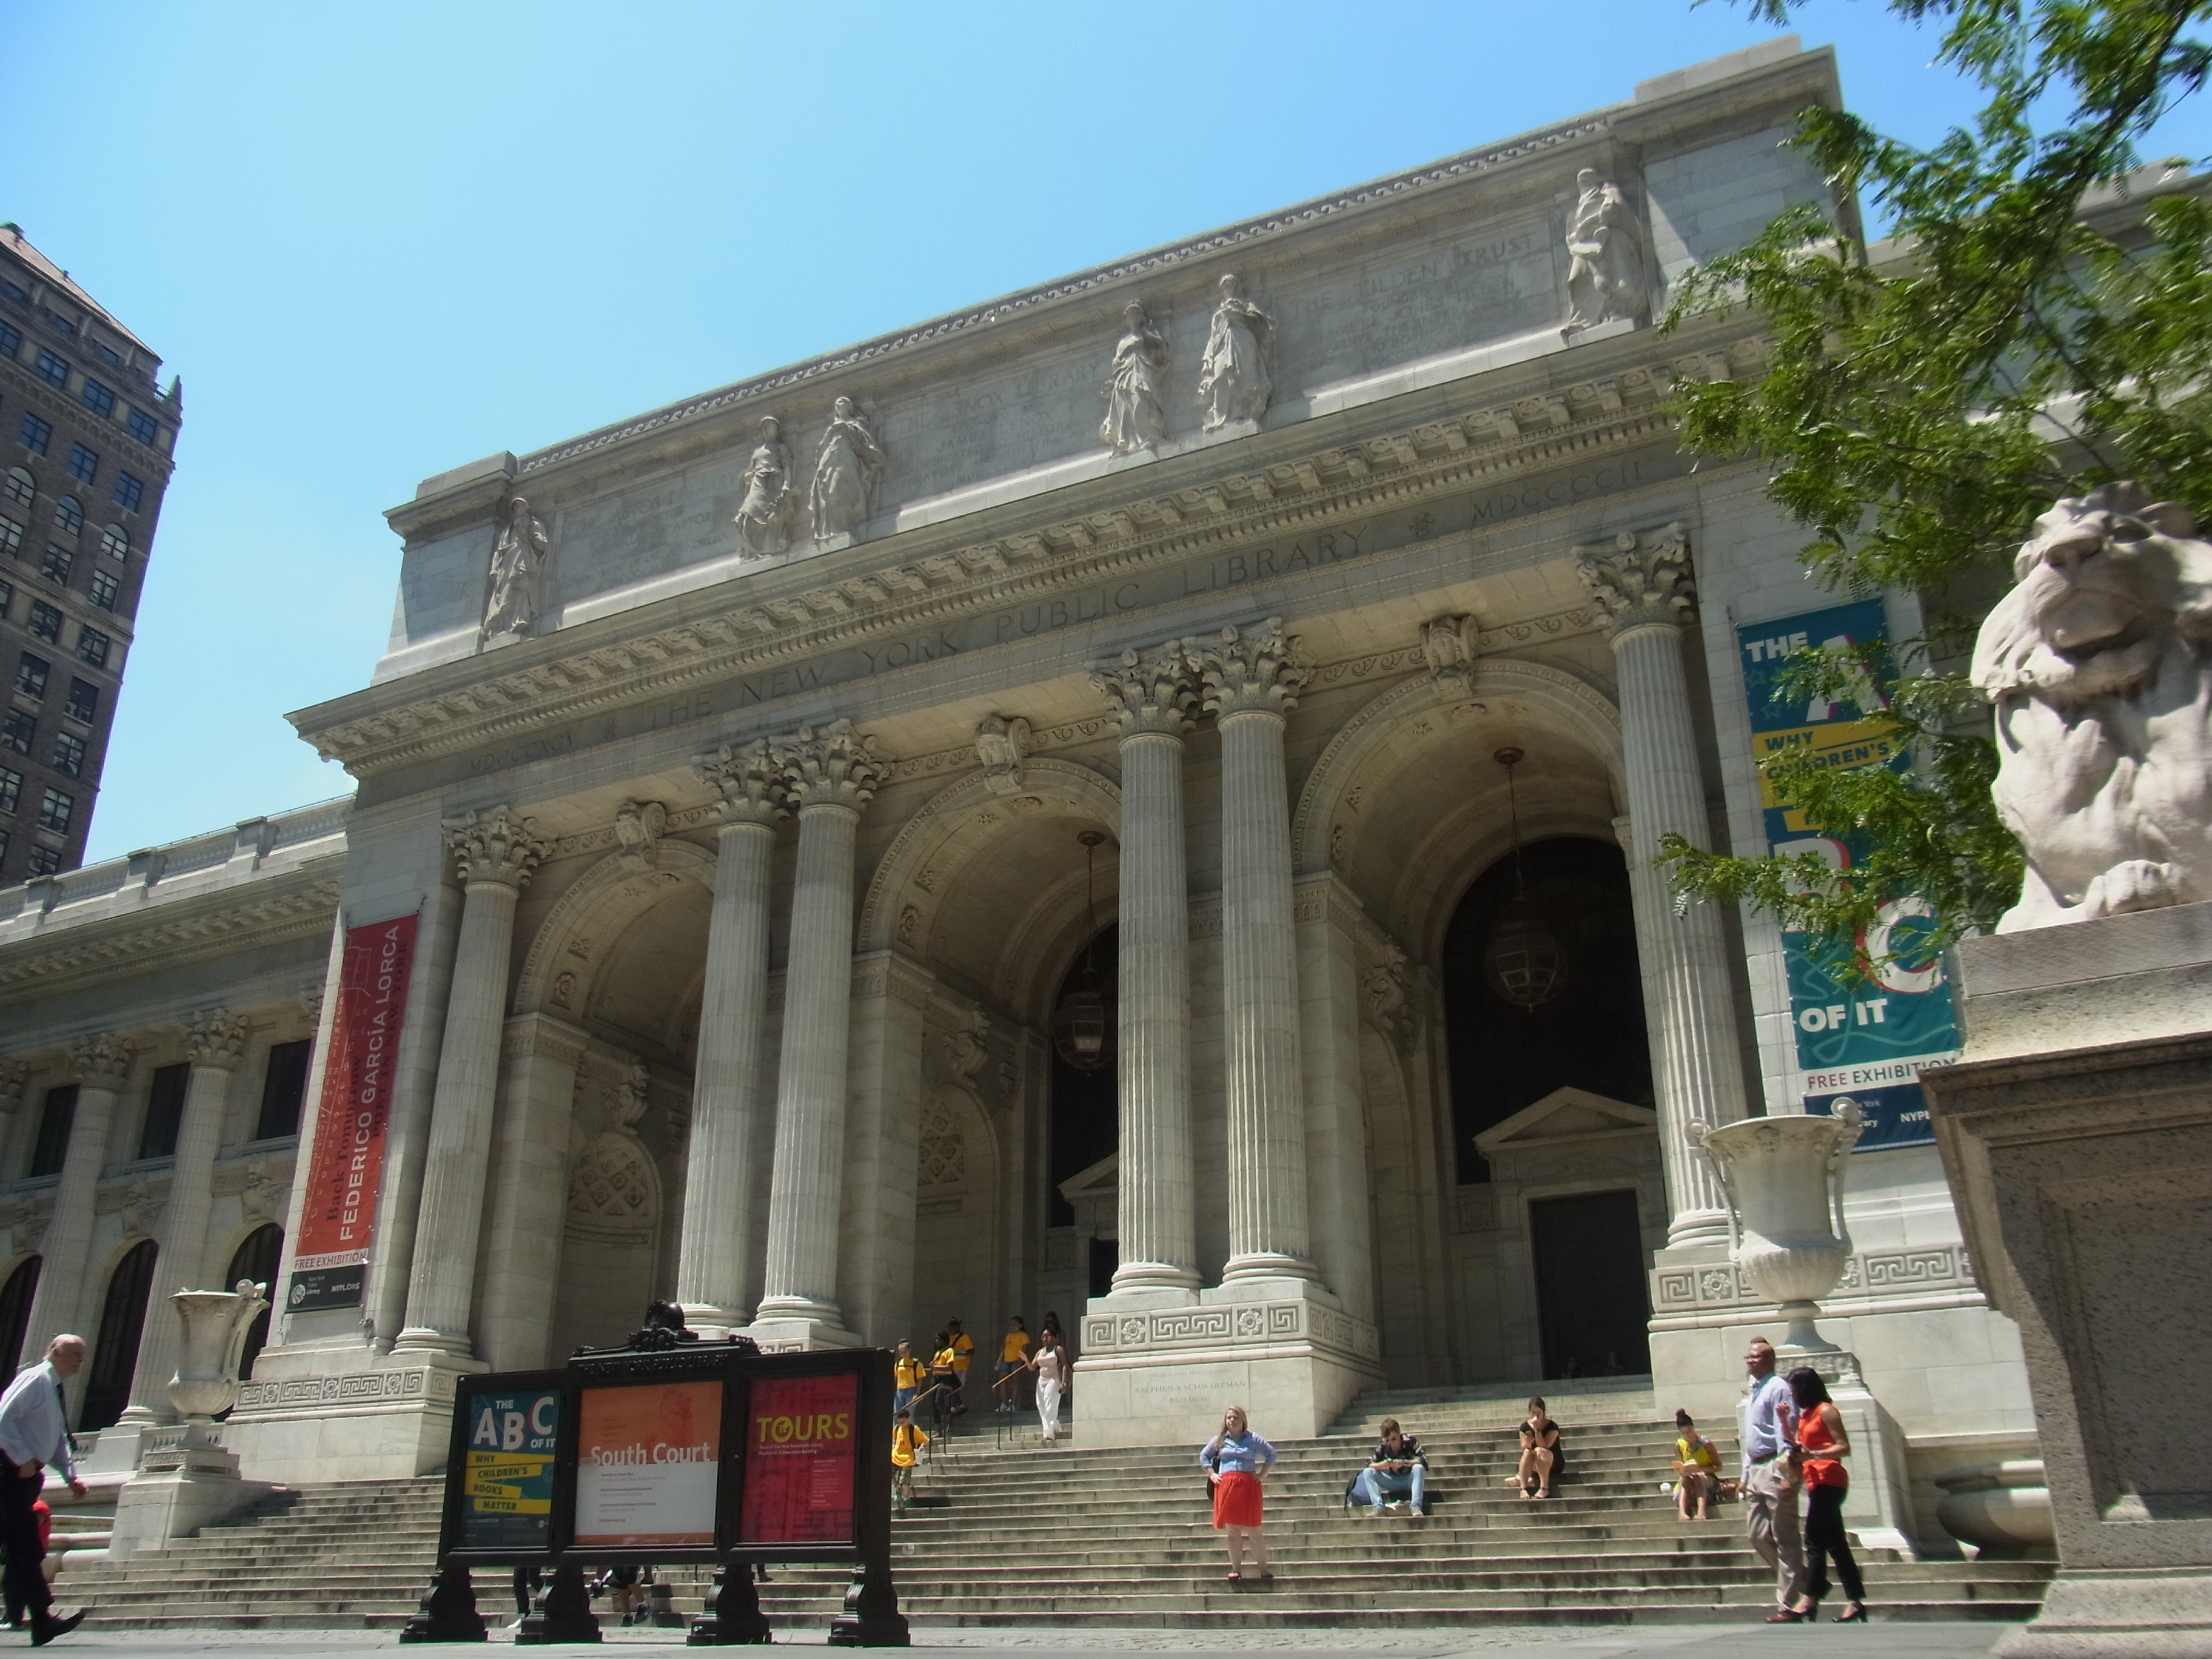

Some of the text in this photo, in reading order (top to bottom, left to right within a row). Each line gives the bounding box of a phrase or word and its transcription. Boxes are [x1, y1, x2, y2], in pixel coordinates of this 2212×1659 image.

[1354, 261, 1437, 298] TILDEN
[1461, 233, 1535, 266] TRUST
[1016, 358, 1101, 398] LIBRARY
[937, 429, 987, 452] JAMES
[647, 691, 712, 729] THE
[741, 660, 828, 706] NEW
[861, 627, 962, 674] YORK
[996, 583, 1140, 643] PUBLIC
[1182, 525, 1369, 595] LIBRARY
[1472, 461, 1640, 521] MDCCCCII
[1746, 631, 1808, 663] THE
[1765, 731, 1813, 751] WHY
[1854, 896, 1943, 994] C
[1799, 998, 1889, 1032] OF IT
[340, 925, 400, 1241] FEDERICO GARCÍA LORCA
[1807, 1072, 1847, 1089] FREE
[326, 1171, 344, 1221] Back
[295, 1252, 366, 1269] FREE EXHIBITION
[1135, 1384, 1174, 1394] STEPHEN
[1183, 1380, 1246, 1391] SCHWARZMAN
[495, 1399, 514, 1409] THE
[756, 1412, 849, 1443] TOURS
[530, 1438, 556, 1449] OF IT
[591, 1441, 711, 1466] South Court
[478, 1466, 528, 1478] CHILDREN'S
[473, 1483, 503, 1495] BOOKS
[483, 1501, 517, 1510] MATTER
